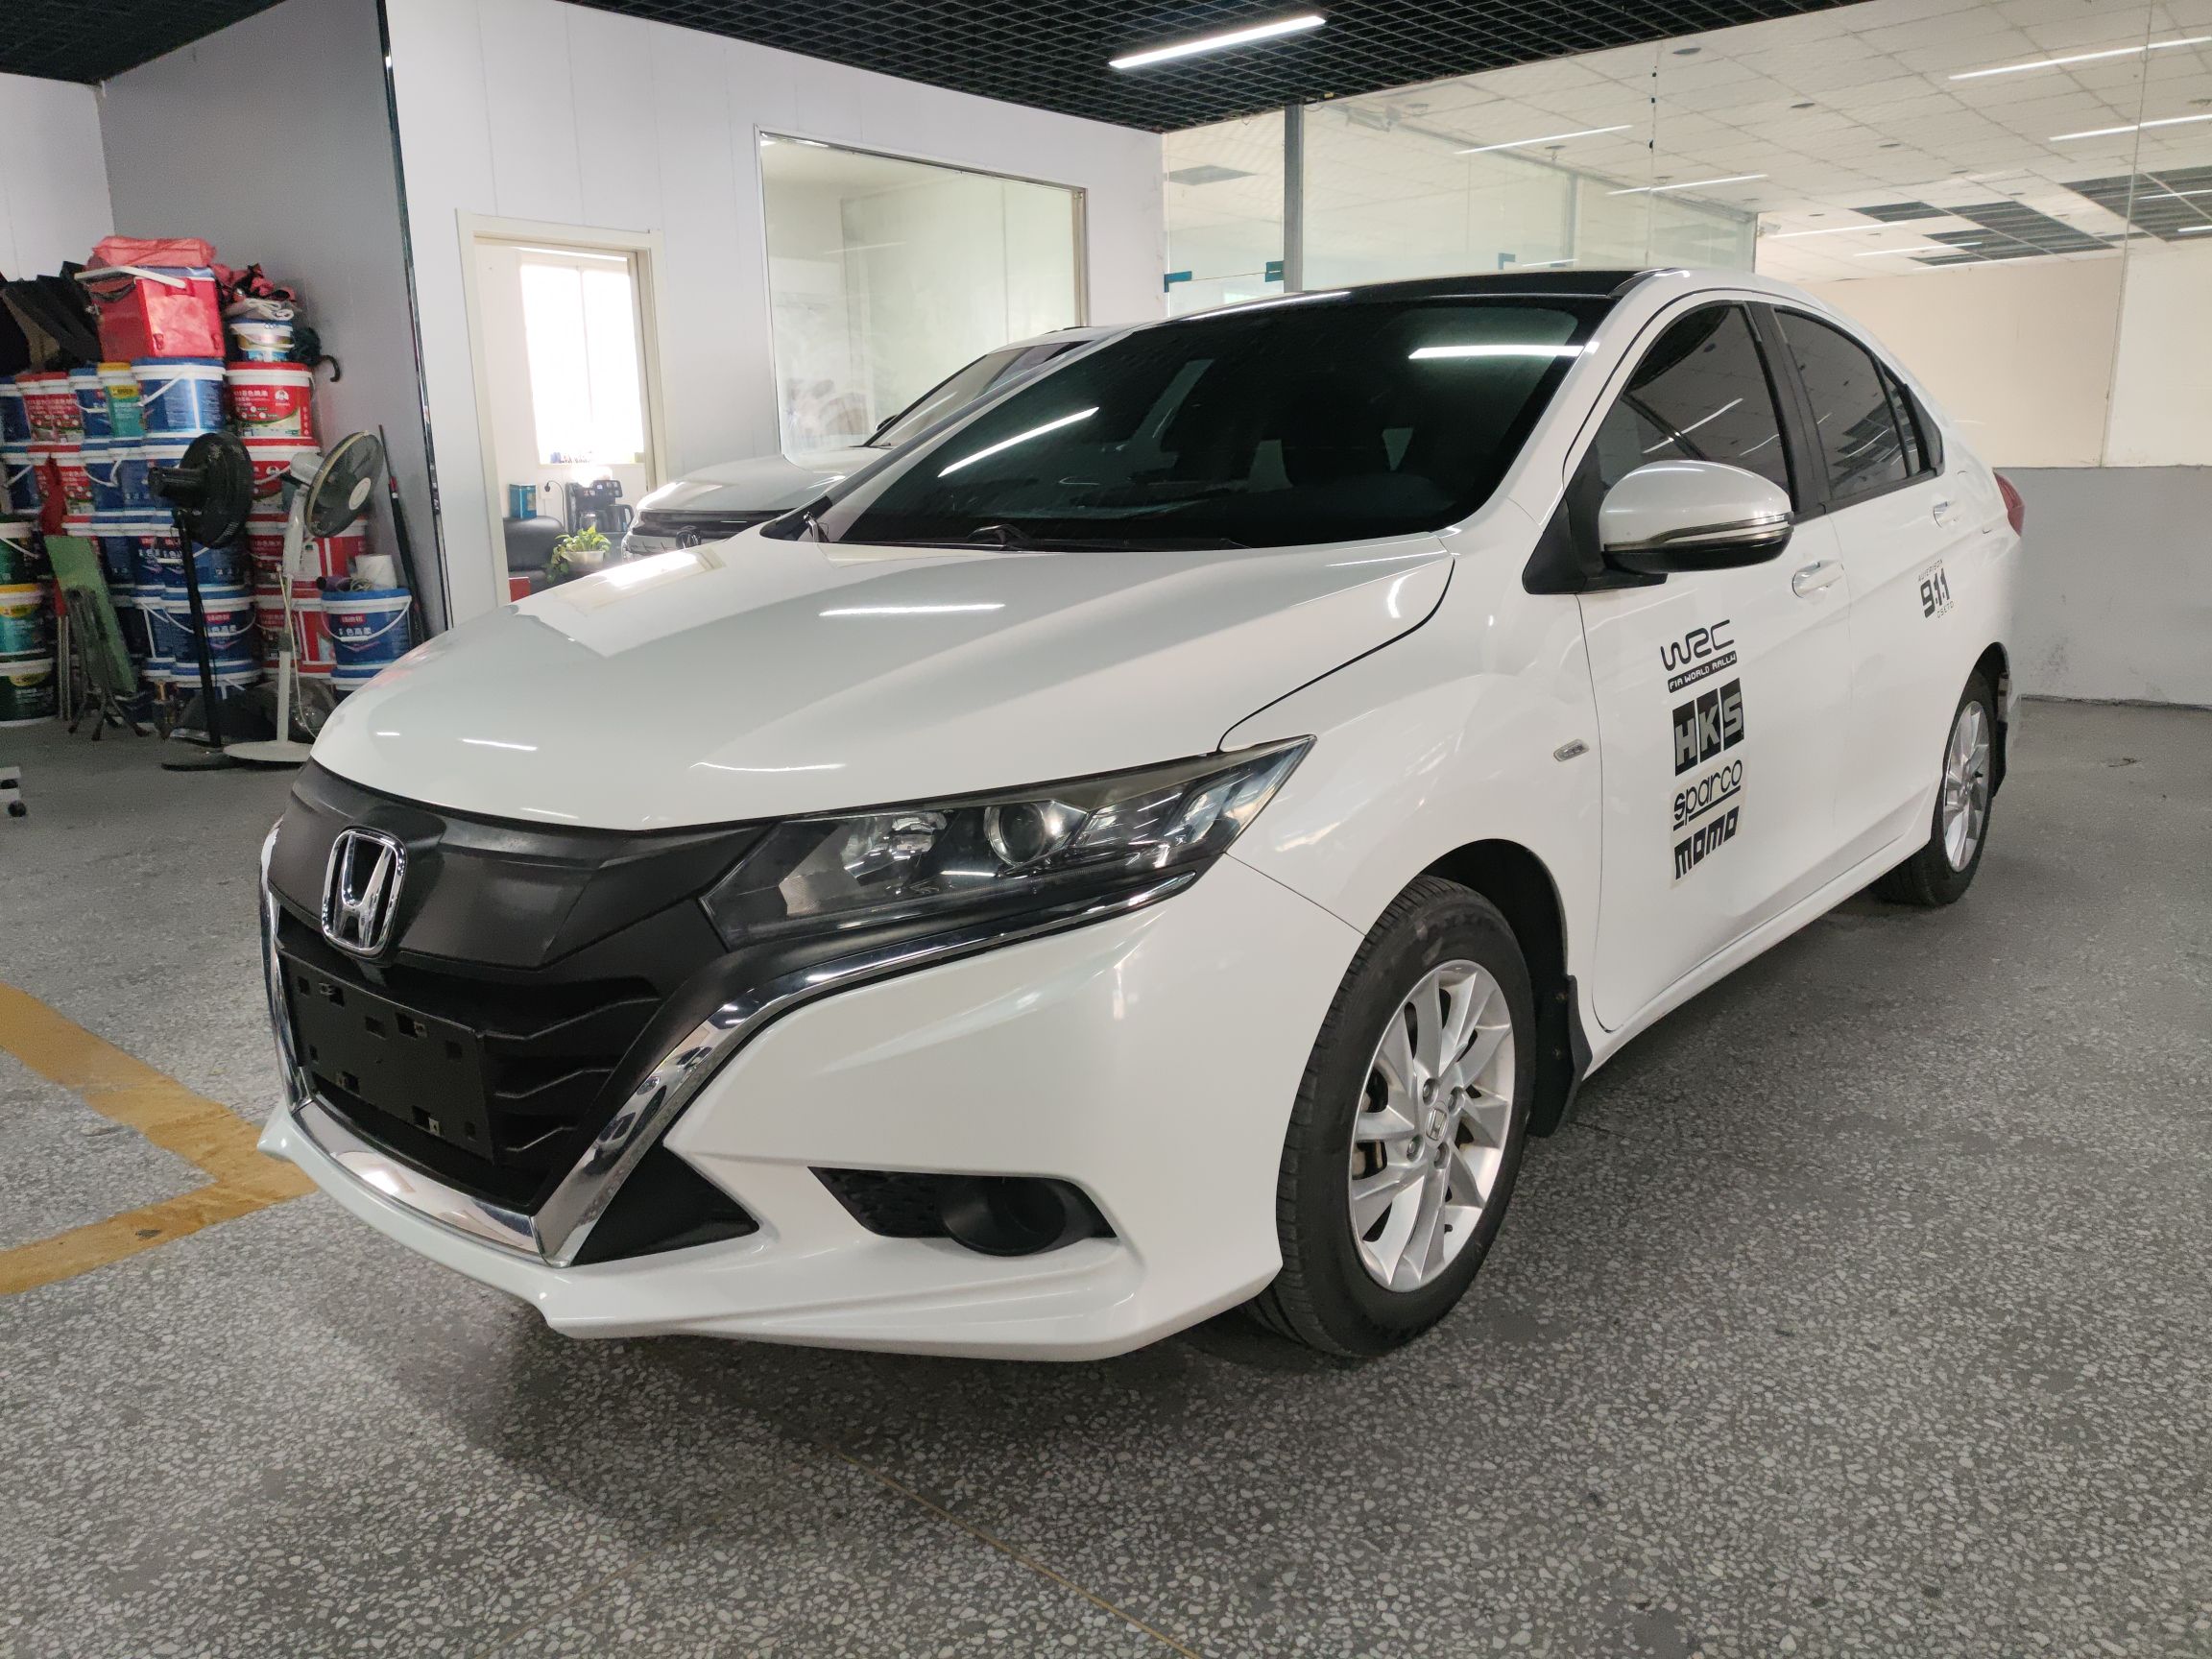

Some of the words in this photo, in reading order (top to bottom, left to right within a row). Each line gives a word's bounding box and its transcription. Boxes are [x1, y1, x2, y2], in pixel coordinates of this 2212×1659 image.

[1920, 567, 1950, 618] 911
[1660, 618, 1735, 672] WRC
[1669, 678, 1684, 690] FIA
[1684, 665, 1710, 684] WORLD
[1712, 653, 1737, 671] RALLY
[1673, 689, 1743, 769] HKS
[1673, 758, 1743, 827] sparco
[1673, 805, 1741, 880] momo
